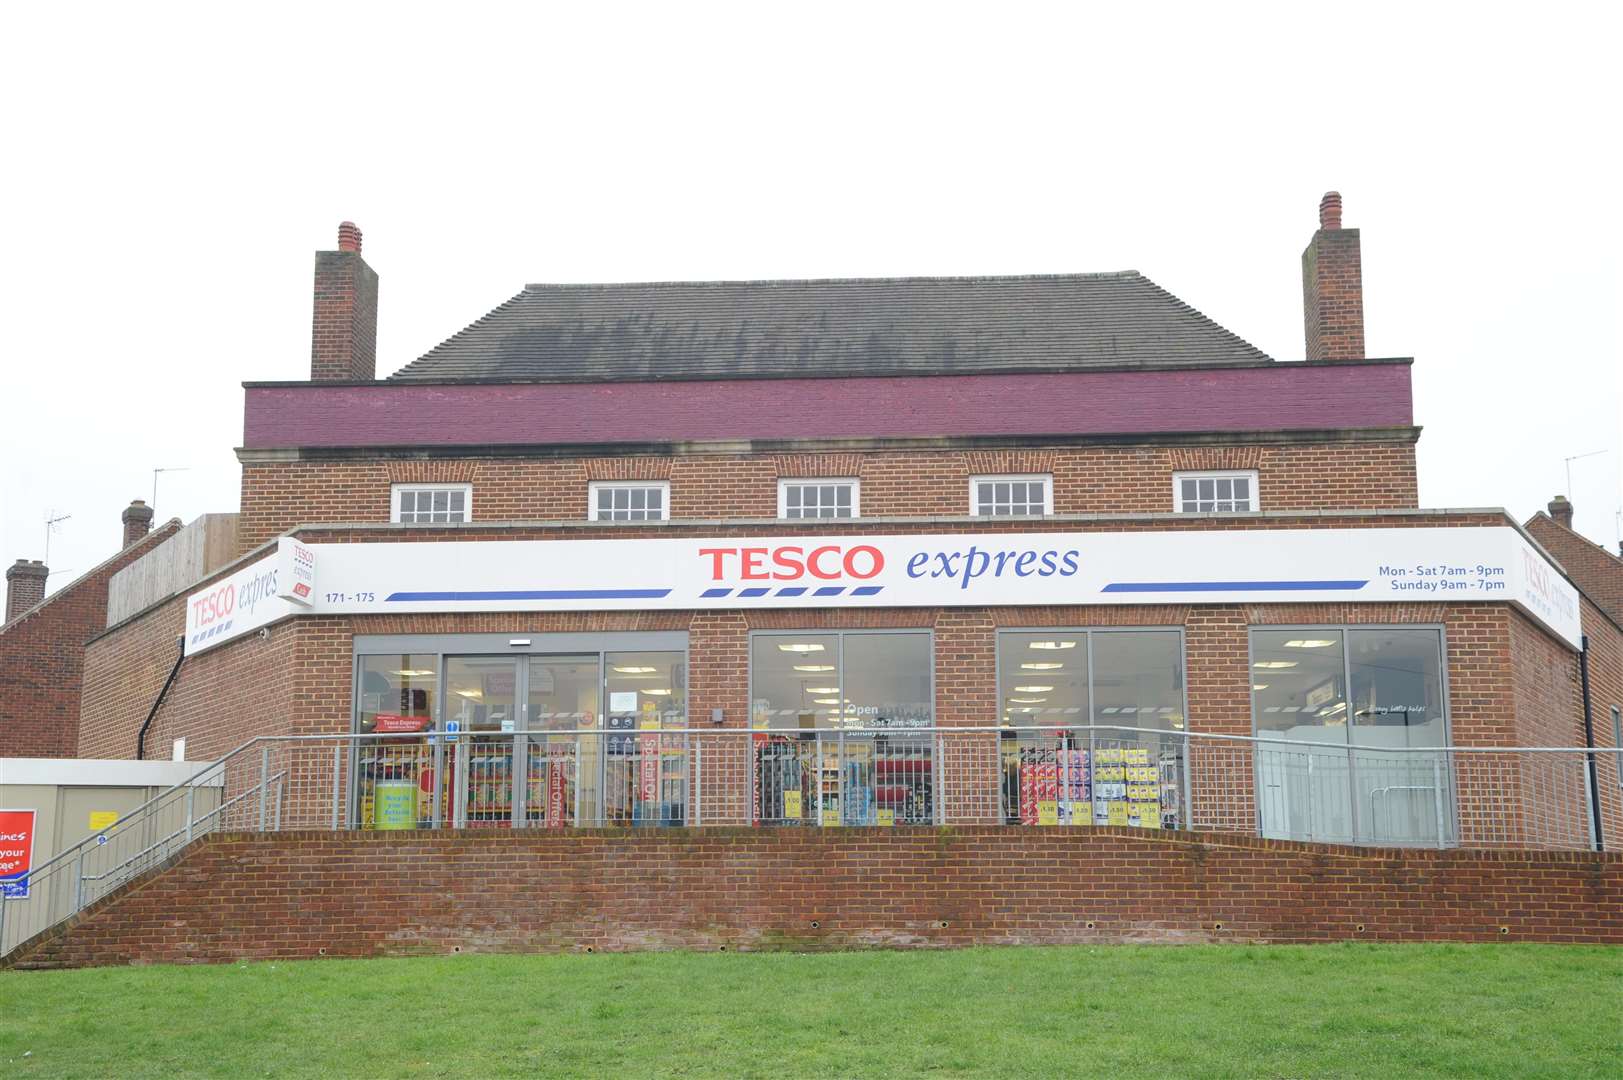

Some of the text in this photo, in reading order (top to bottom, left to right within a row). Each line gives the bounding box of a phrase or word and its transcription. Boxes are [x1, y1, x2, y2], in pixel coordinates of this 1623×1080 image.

[294, 545, 314, 562] TESCO
[699, 545, 1080, 589] TESCO express
[1379, 566, 1406, 576] Mon
[1416, 566, 1437, 576] Sat
[1440, 566, 1466, 576] 7am
[1476, 565, 1504, 577] 9pm
[1391, 580, 1437, 592] Sunday
[1440, 579, 1467, 590] 9am
[1478, 579, 1505, 591] 7pm
[193, 568, 279, 629] TESCO expres
[326, 593, 345, 603] 171
[355, 592, 375, 602] 175
[847, 703, 879, 716] Open
[871, 719, 884, 727] Sat
[644, 739, 656, 783] Spcial
[551, 753, 562, 789] pecial
[0, 831, 26, 841] ines
